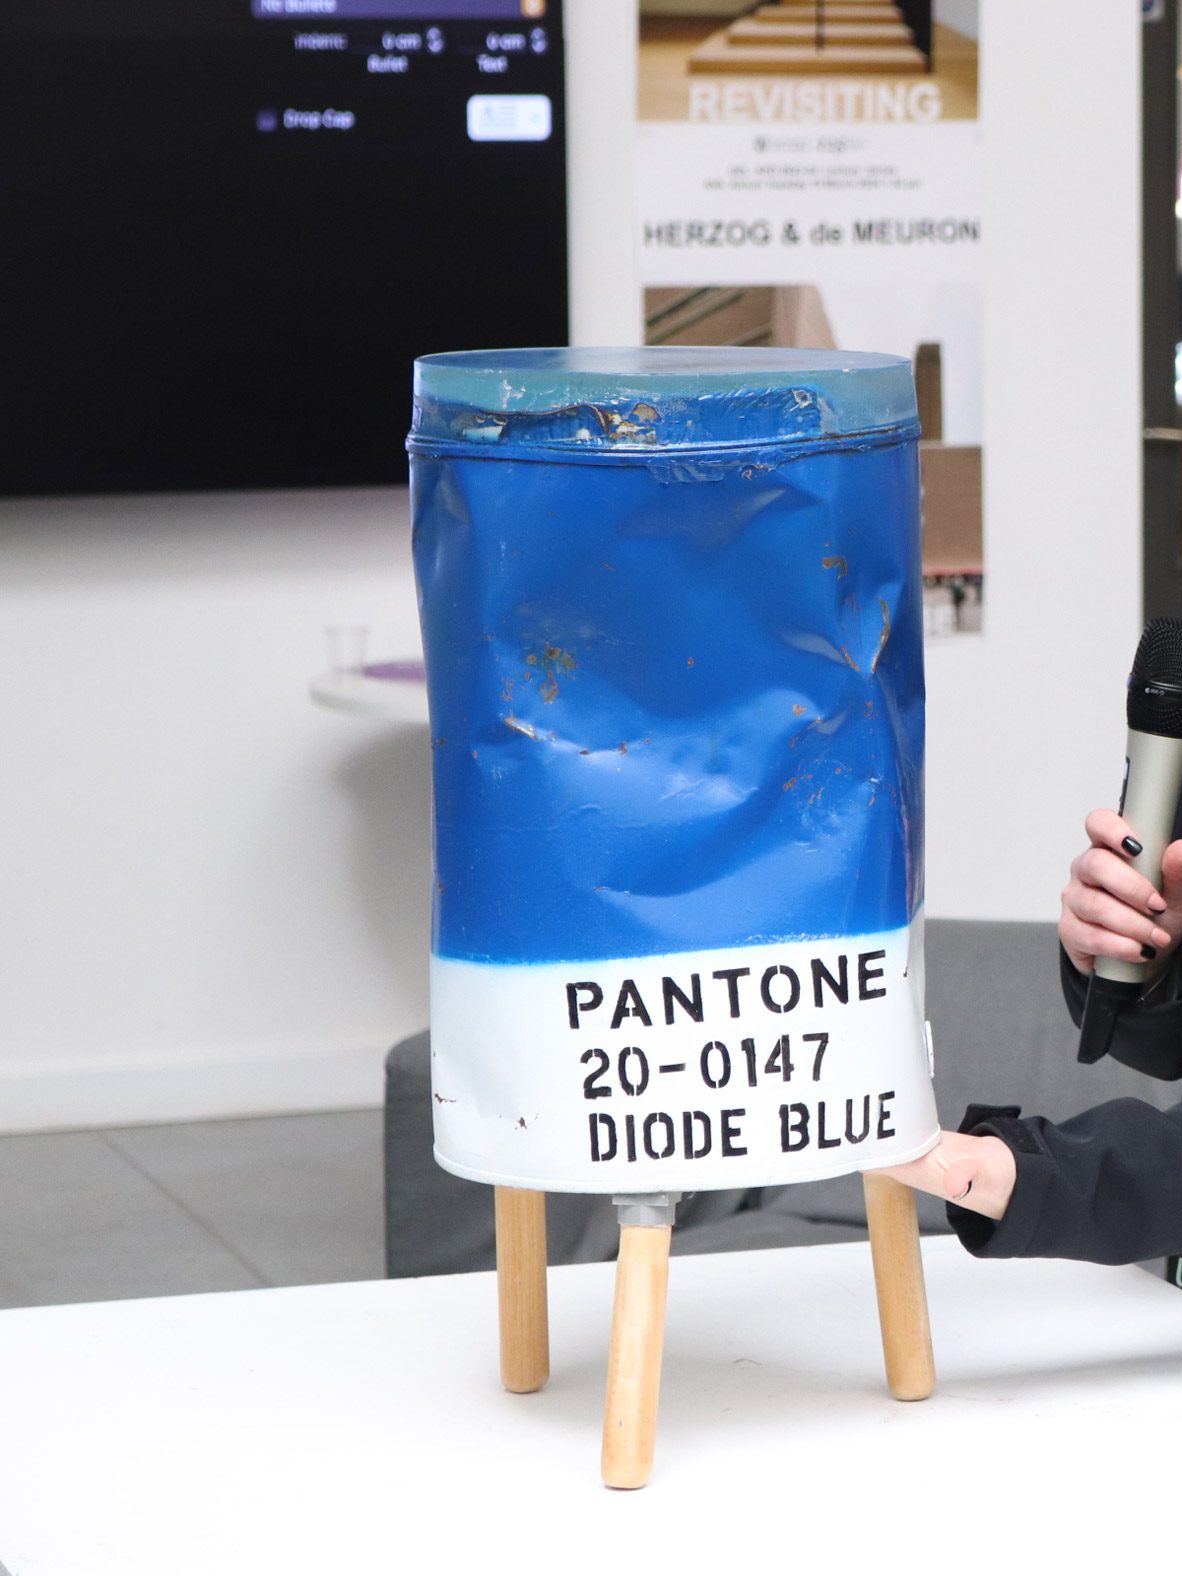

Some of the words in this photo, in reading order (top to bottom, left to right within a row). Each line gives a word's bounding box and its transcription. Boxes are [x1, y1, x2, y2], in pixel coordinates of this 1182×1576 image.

[477, 55, 508, 72] Text
[284, 109, 321, 129] Drop
[322, 109, 354, 129] Cap
[689, 83, 942, 122] REVISITING
[645, 221, 770, 246] HERZOG
[782, 222, 799, 244] &
[810, 221, 841, 243] de
[855, 219, 981, 244] MEURON
[566, 949, 887, 1030] PANTONE
[580, 1033, 829, 1099] 20-0147
[588, 1108, 748, 1162] DIODE
[779, 1091, 896, 1153] BLUE
